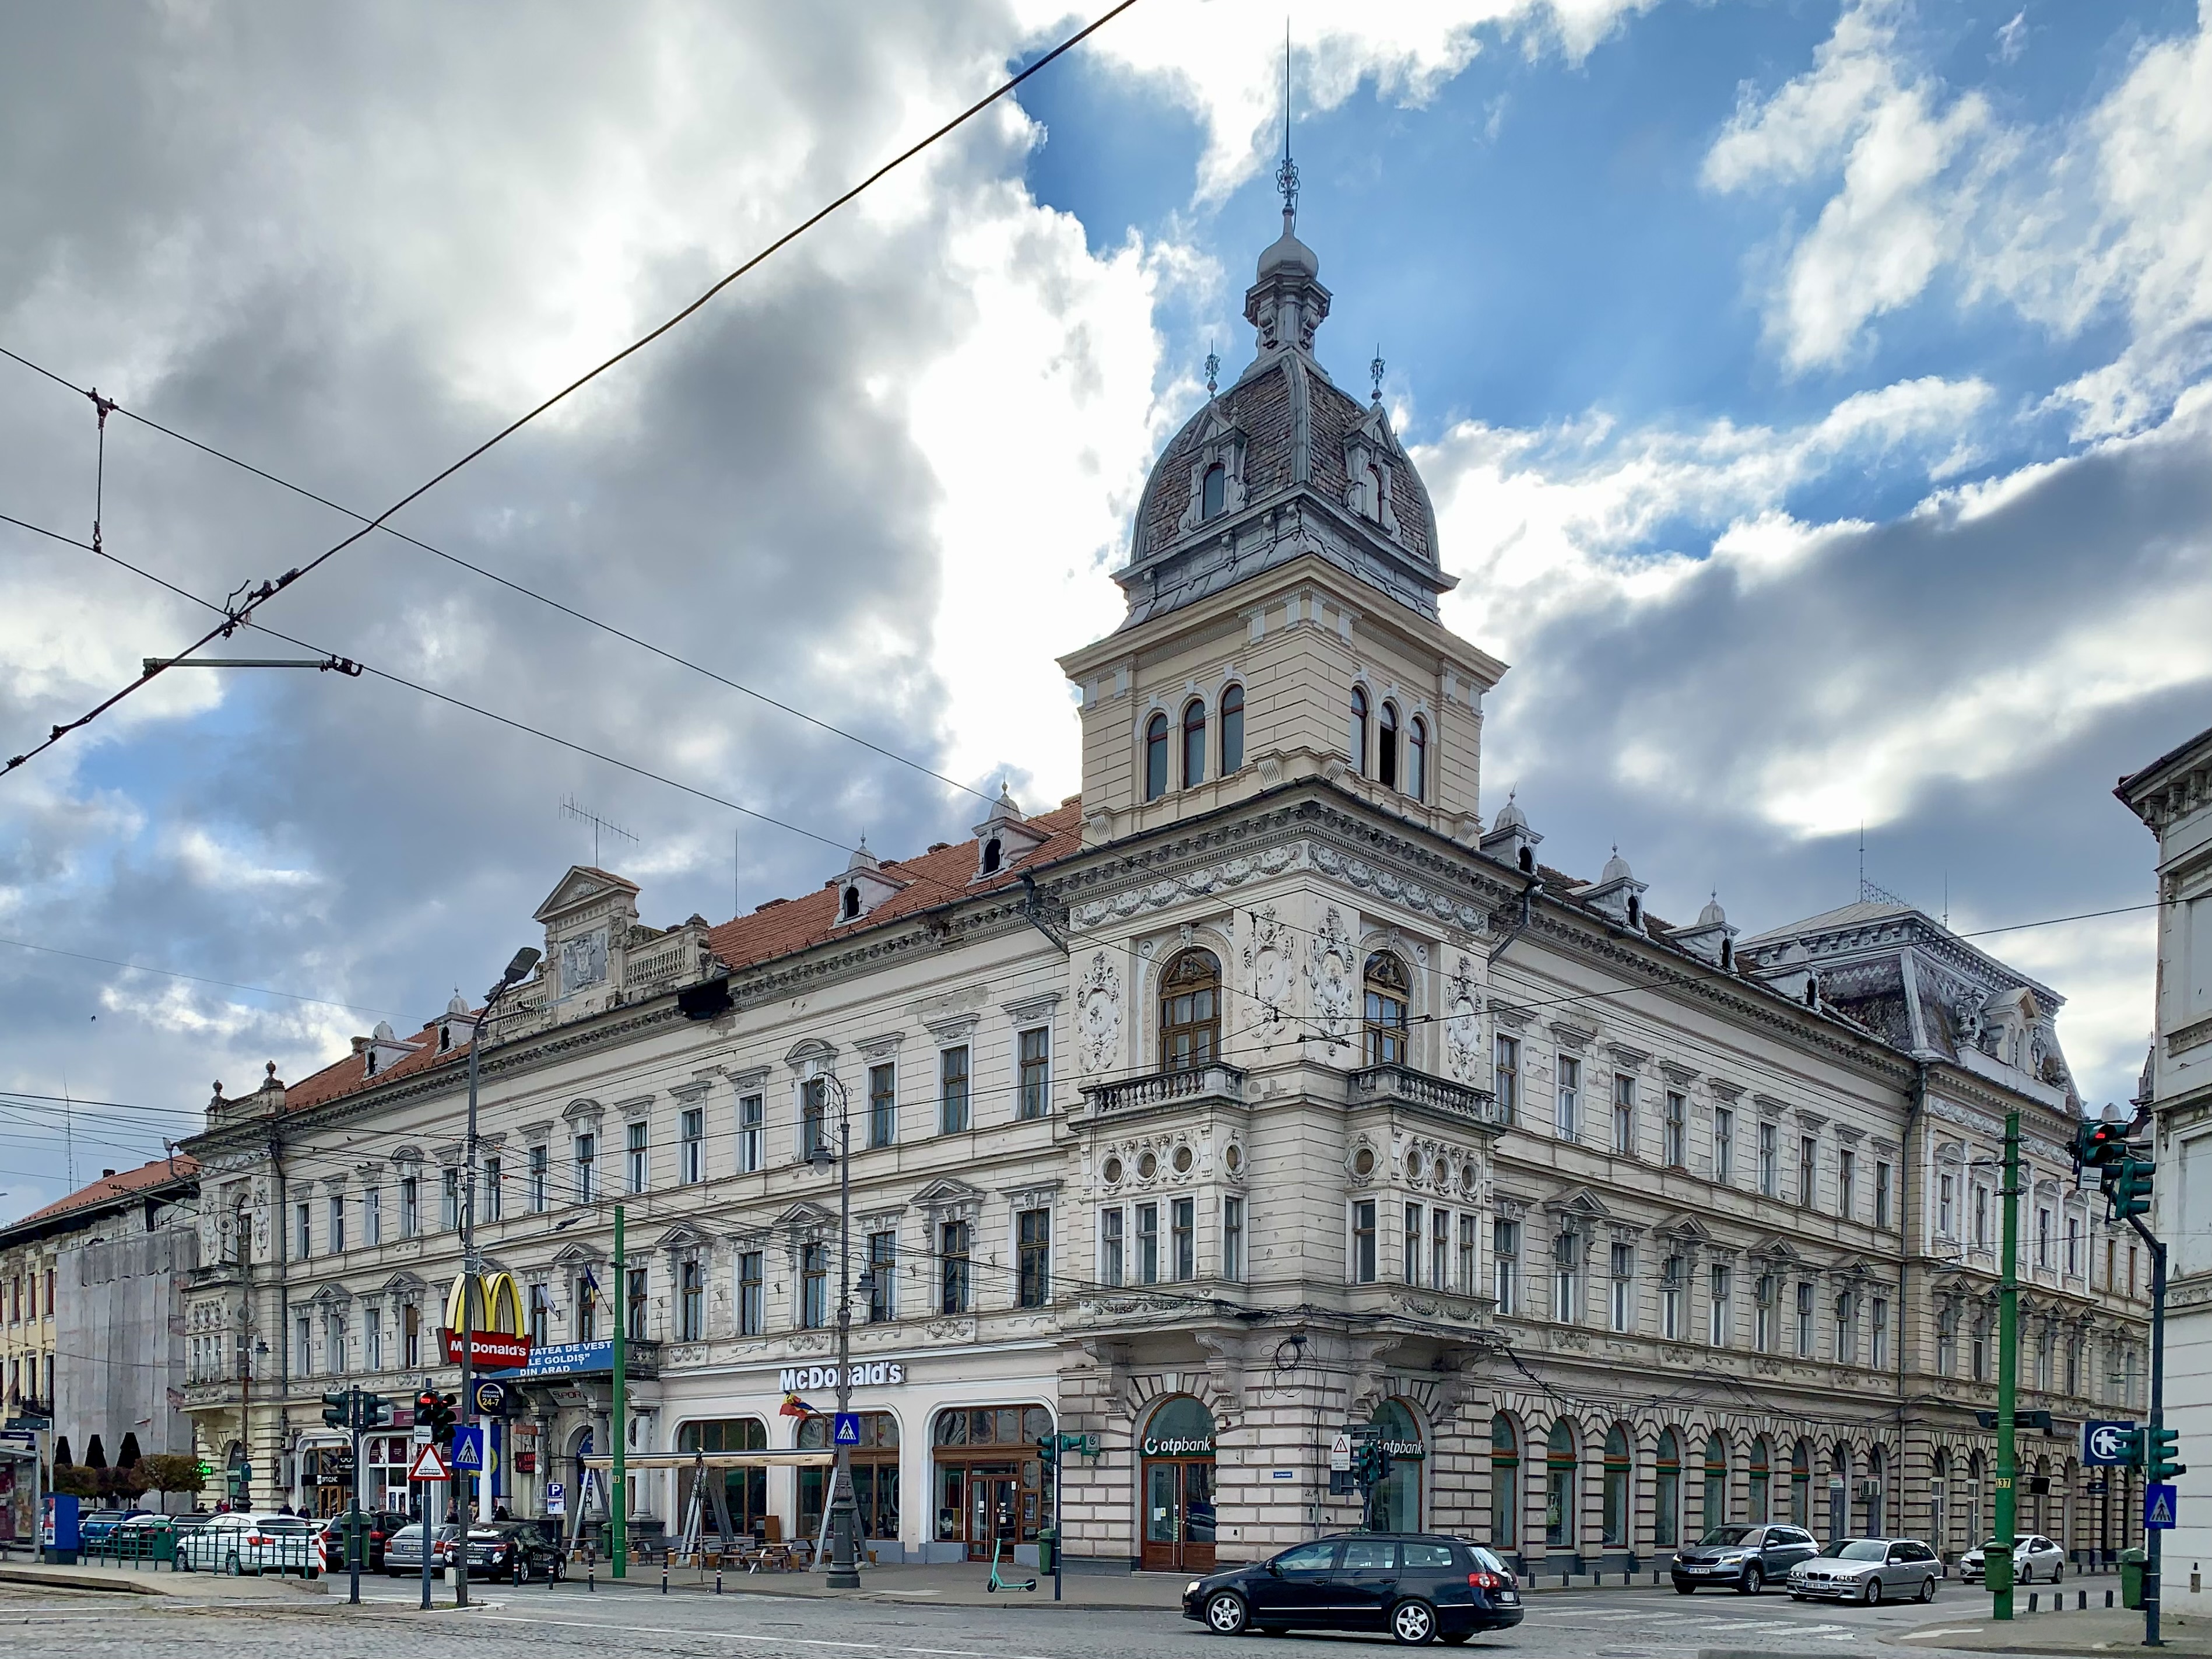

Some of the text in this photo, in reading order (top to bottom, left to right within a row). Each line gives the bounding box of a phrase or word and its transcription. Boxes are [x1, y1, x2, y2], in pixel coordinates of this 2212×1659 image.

[450, 1340, 526, 1356] MDonald's
[565, 1344, 580, 1353] DE
[583, 1341, 612, 1351] VEST
[519, 1365, 571, 1376] DIN ARAD
[482, 1398, 500, 1407] 24-7
[1160, 1436, 1211, 1456] otpbank
[1383, 1439, 1424, 1455] otpbank
[552, 1485, 560, 1495] P
